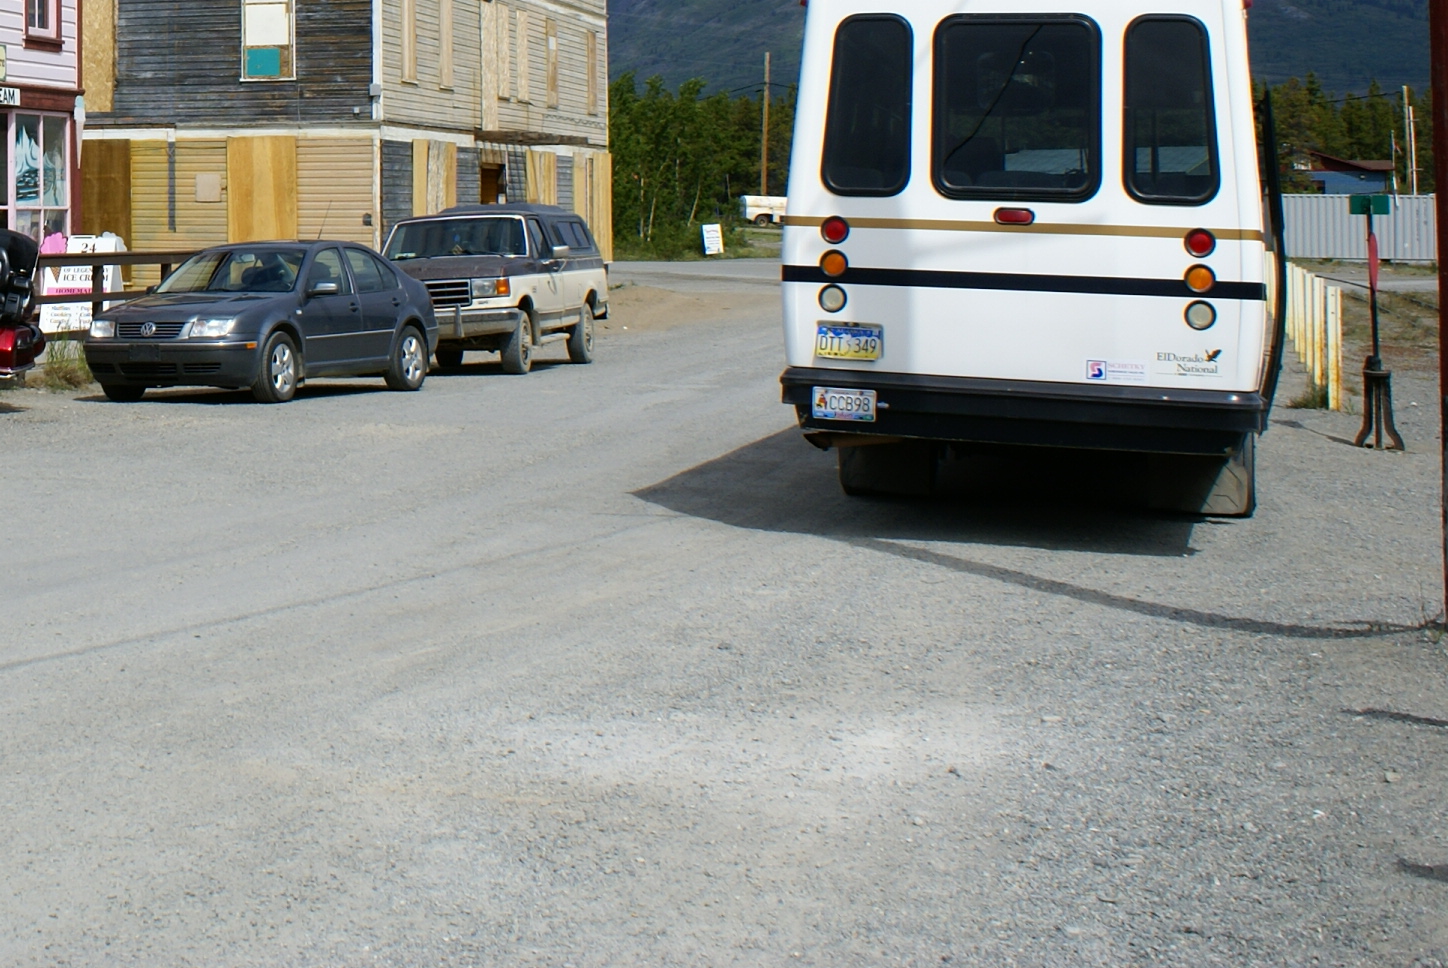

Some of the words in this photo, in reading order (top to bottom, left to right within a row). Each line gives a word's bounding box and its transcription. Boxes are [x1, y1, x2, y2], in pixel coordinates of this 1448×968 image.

[1156, 351, 1205, 363] ElDorado
[1176, 363, 1219, 374] National
[829, 395, 870, 412] CCB98
